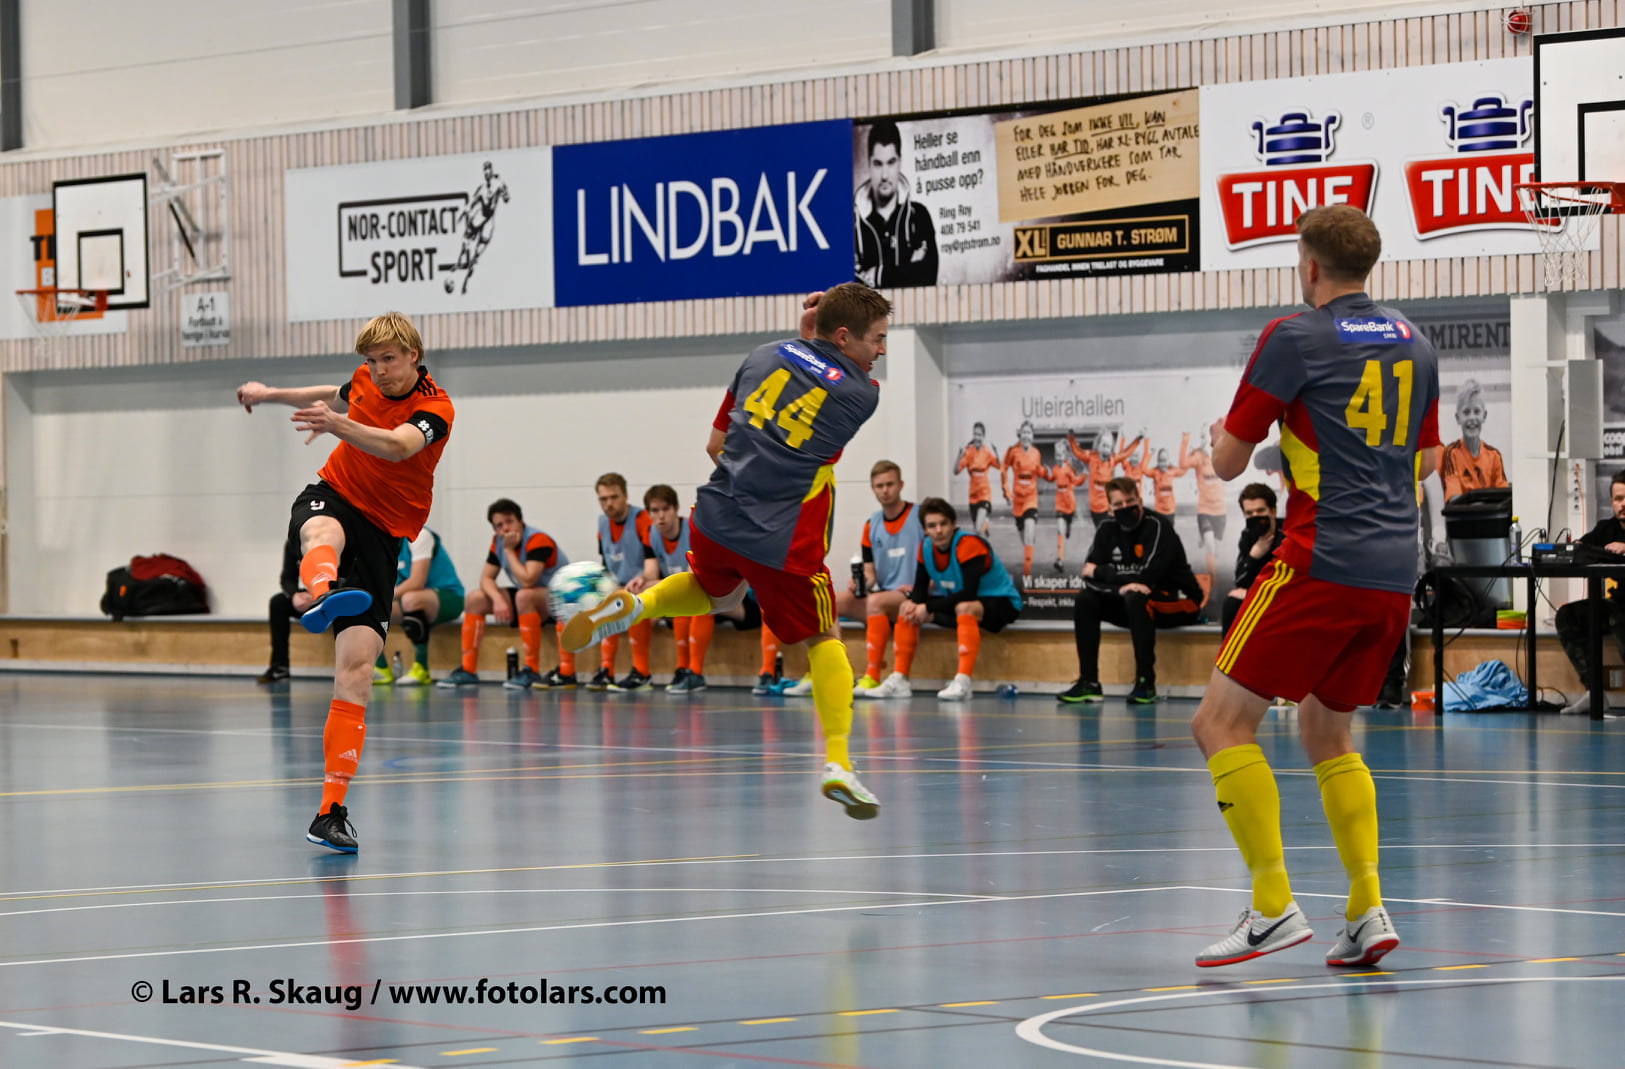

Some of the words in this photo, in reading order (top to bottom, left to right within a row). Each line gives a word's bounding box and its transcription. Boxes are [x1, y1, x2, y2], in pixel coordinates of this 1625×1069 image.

[913, 132, 943, 151] Heller
[946, 131, 958, 146] se
[1013, 124, 1033, 142] FOR
[1038, 123, 1056, 138] DEG
[1062, 120, 1082, 136] SOM
[1089, 114, 1112, 131] IKKE
[1144, 110, 1165, 126] KAN
[1015, 143, 1044, 161] ELLER
[1049, 140, 1069, 156] HAR
[1096, 136, 1114, 152] HAR
[1162, 124, 1200, 142] AVTALE
[915, 150, 958, 172] håndball
[961, 150, 982, 166] enn
[1017, 165, 1042, 181] MED
[1045, 154, 1121, 178] HÅNDVERKERE
[1128, 150, 1153, 166] SOM
[1160, 145, 1182, 160] TAR
[916, 176, 922, 195] å
[926, 176, 956, 196] pusse
[959, 168, 985, 190] opp?
[1019, 185, 1046, 203] HELE
[1051, 179, 1090, 201] JOBBEN
[1095, 175, 1121, 190] FOR
[577, 168, 831, 266] LINDBAK
[939, 206, 956, 220] Ring
[958, 204, 972, 217] Roy
[1232, 176, 1353, 228] TINE
[348, 206, 459, 241] NOR-CONTACT
[956, 222, 967, 235] 79
[967, 219, 980, 232] 541
[1016, 230, 1046, 257] XL
[1057, 231, 1113, 250] GUNNAR
[1115, 231, 1128, 246] T.
[1131, 227, 1178, 245] STRØM
[371, 247, 437, 284] SPORT
[1341, 320, 1394, 334] SpareBank
[744, 368, 828, 449] 44
[1021, 394, 1125, 419] Utleirahallen
[1345, 359, 1413, 446] 41
[1022, 575, 1034, 589] Vi
[1035, 575, 1067, 591] skaper
